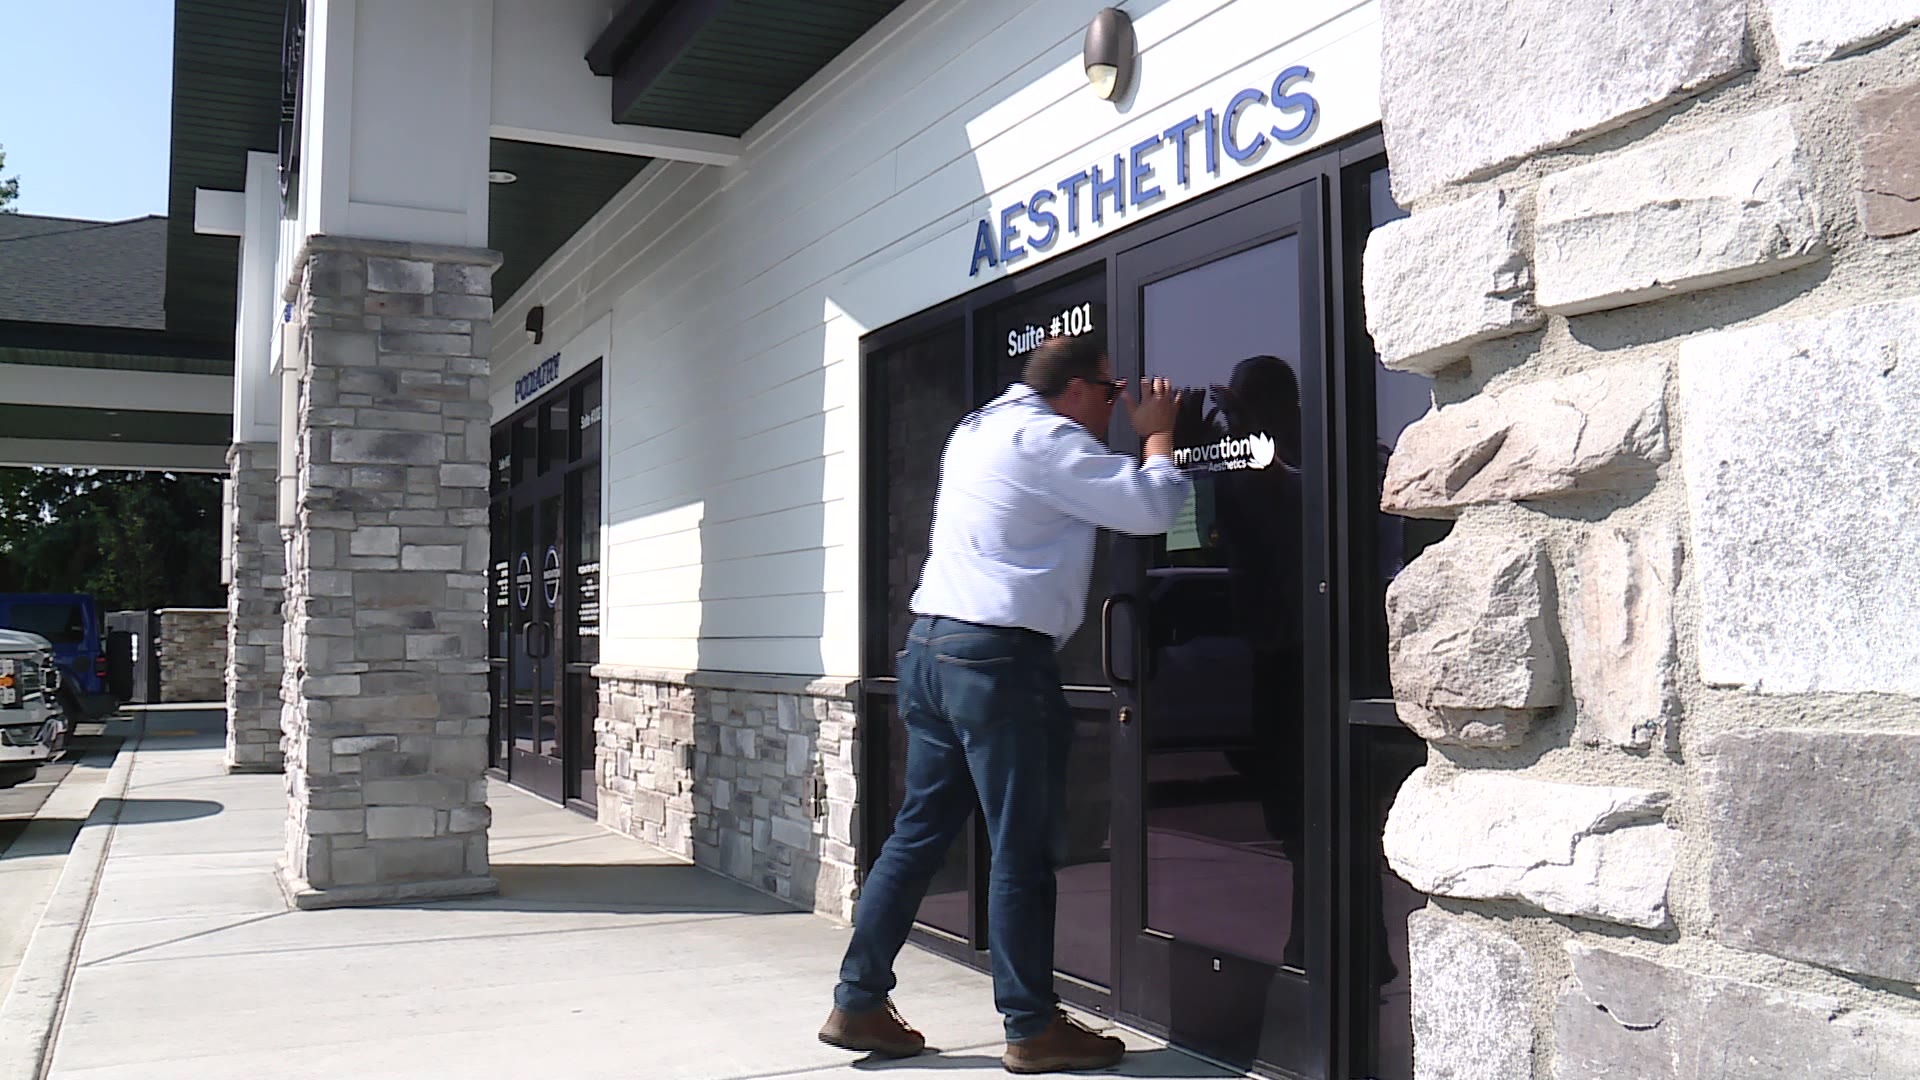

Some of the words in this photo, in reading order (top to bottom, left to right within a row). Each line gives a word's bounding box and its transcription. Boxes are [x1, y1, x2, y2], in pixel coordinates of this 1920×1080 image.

[969, 65, 1317, 277] AESTHETICS
[1008, 324, 1045, 357] Suite
[1050, 302, 1093, 337] #101
[514, 352, 561, 404] PODIATRY
[1172, 435, 1251, 466] nnovation
[1208, 458, 1247, 472] Aesthetics
